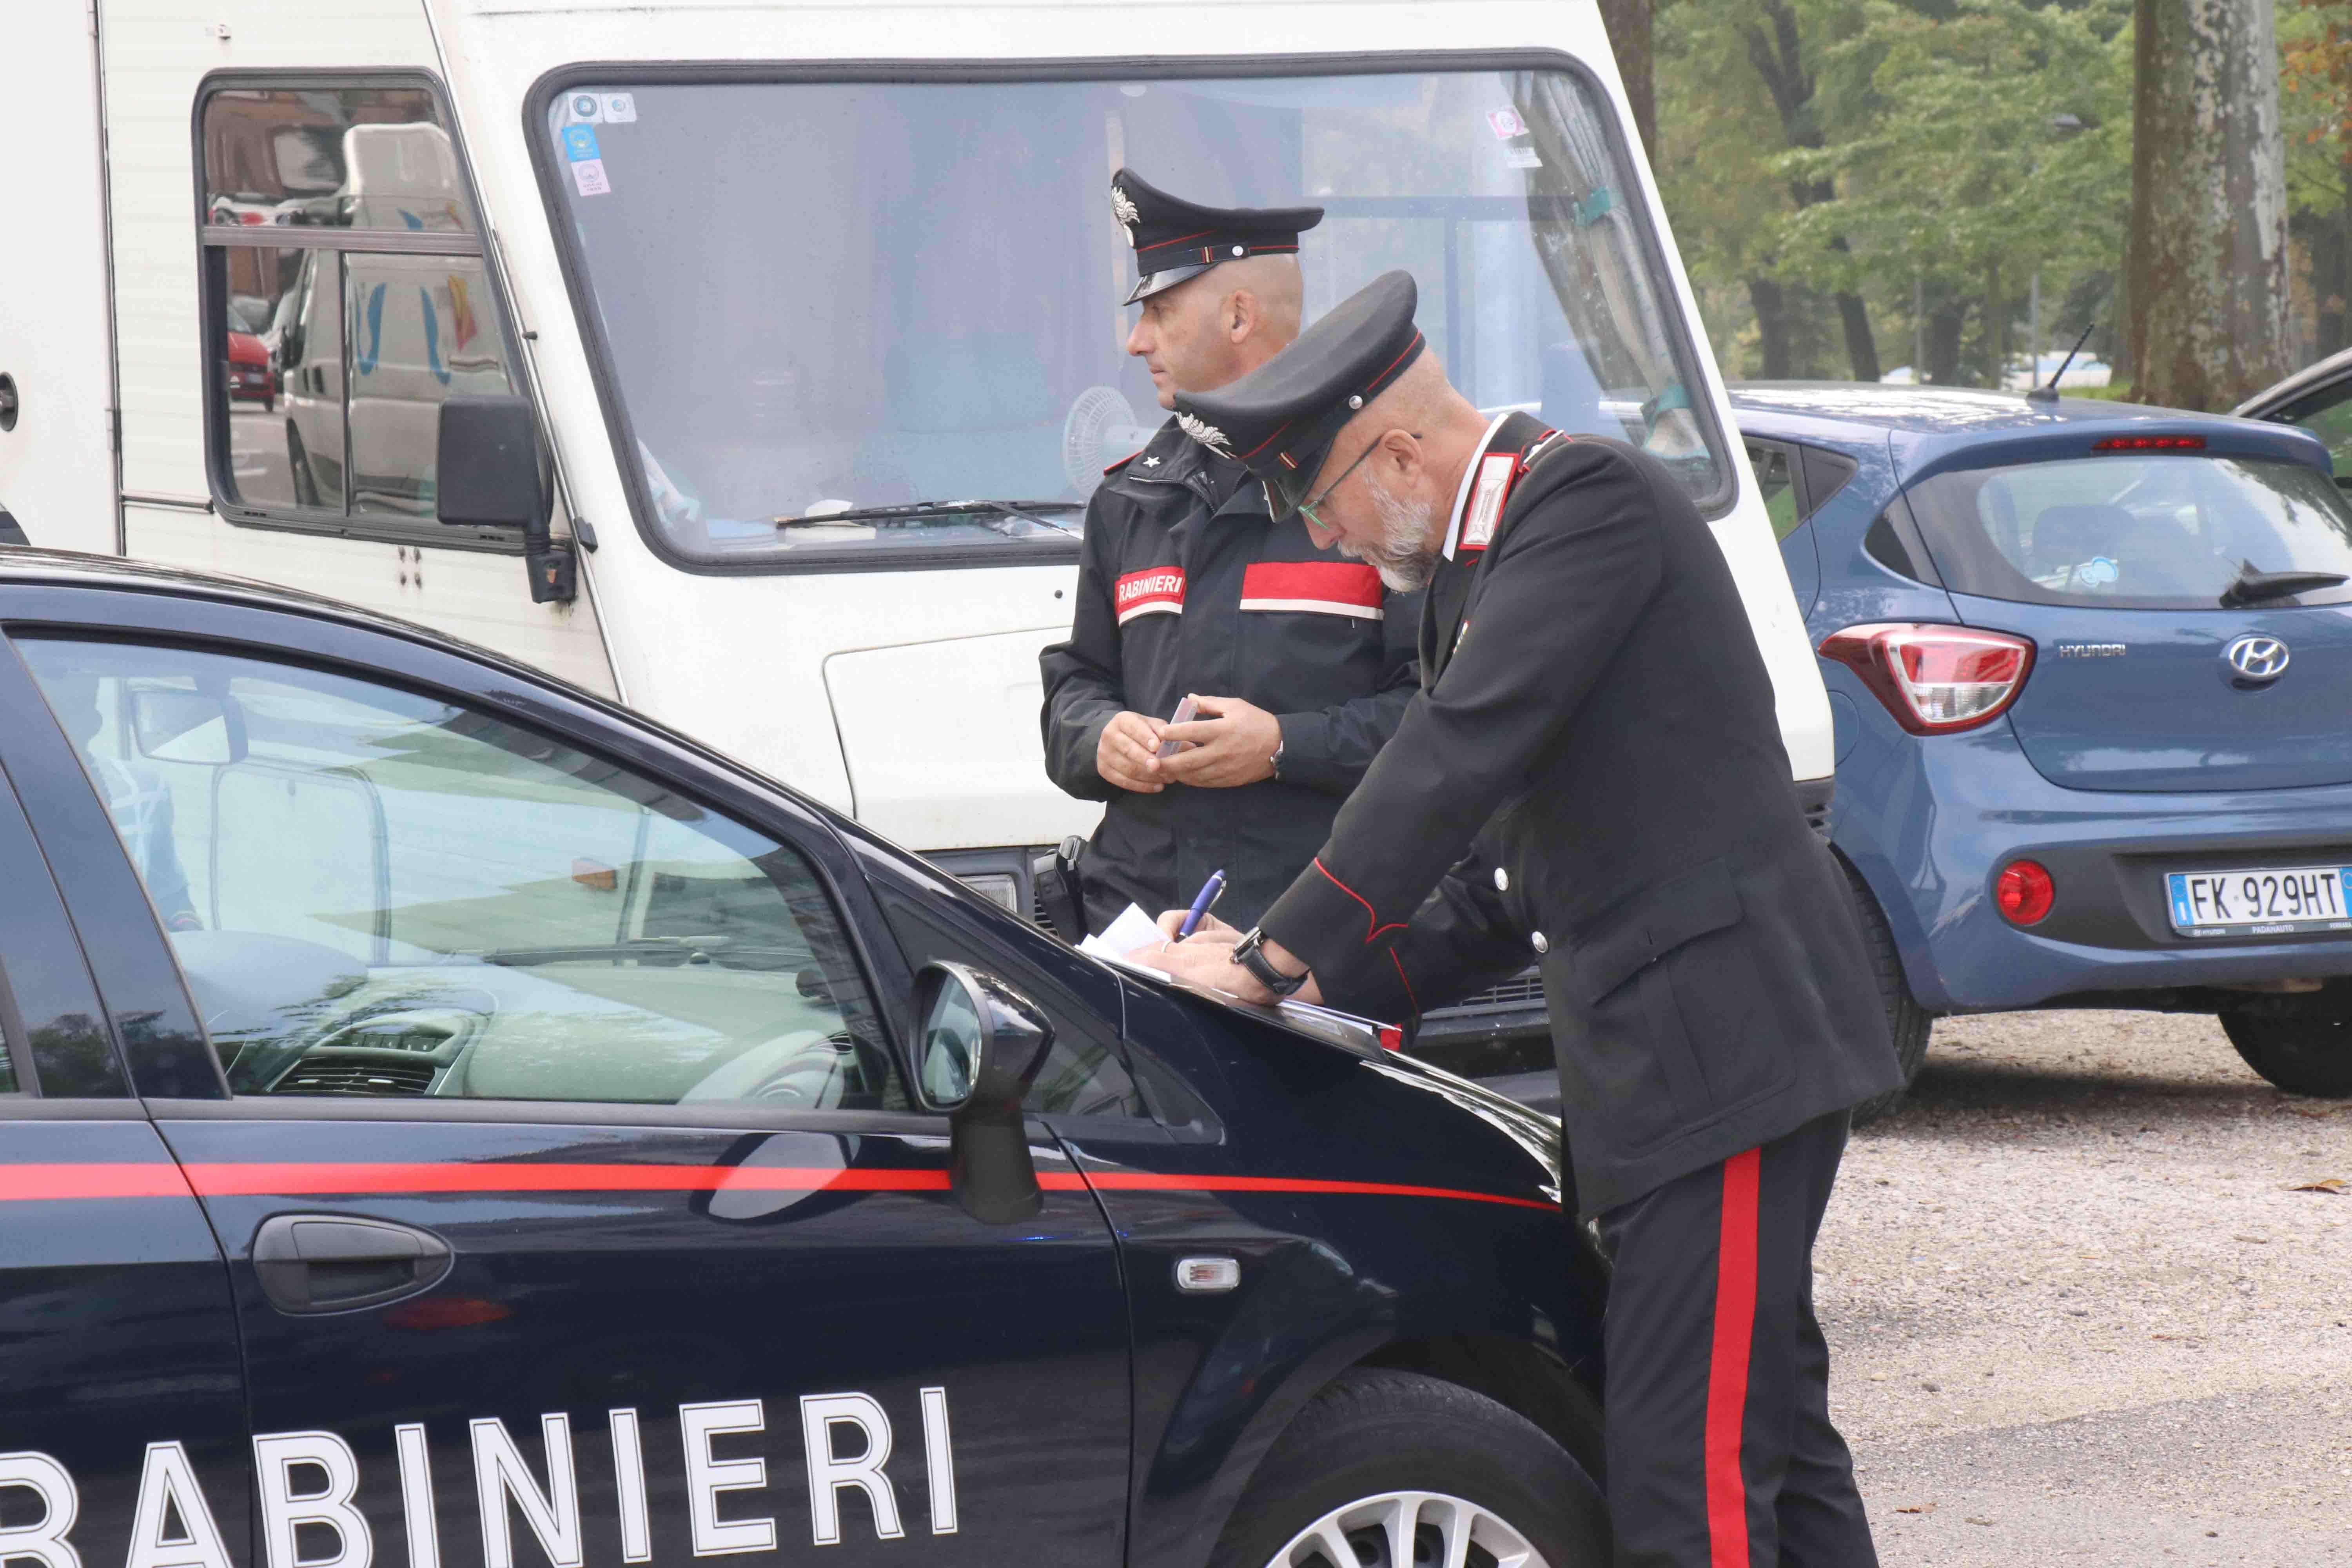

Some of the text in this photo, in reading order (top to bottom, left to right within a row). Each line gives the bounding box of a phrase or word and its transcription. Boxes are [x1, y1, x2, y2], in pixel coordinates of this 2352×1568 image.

[1118, 575, 1183, 603] RABINIERI
[2060, 644, 2126, 659] HYUNDAI
[2252, 924, 2294, 935] PADANAUTO
